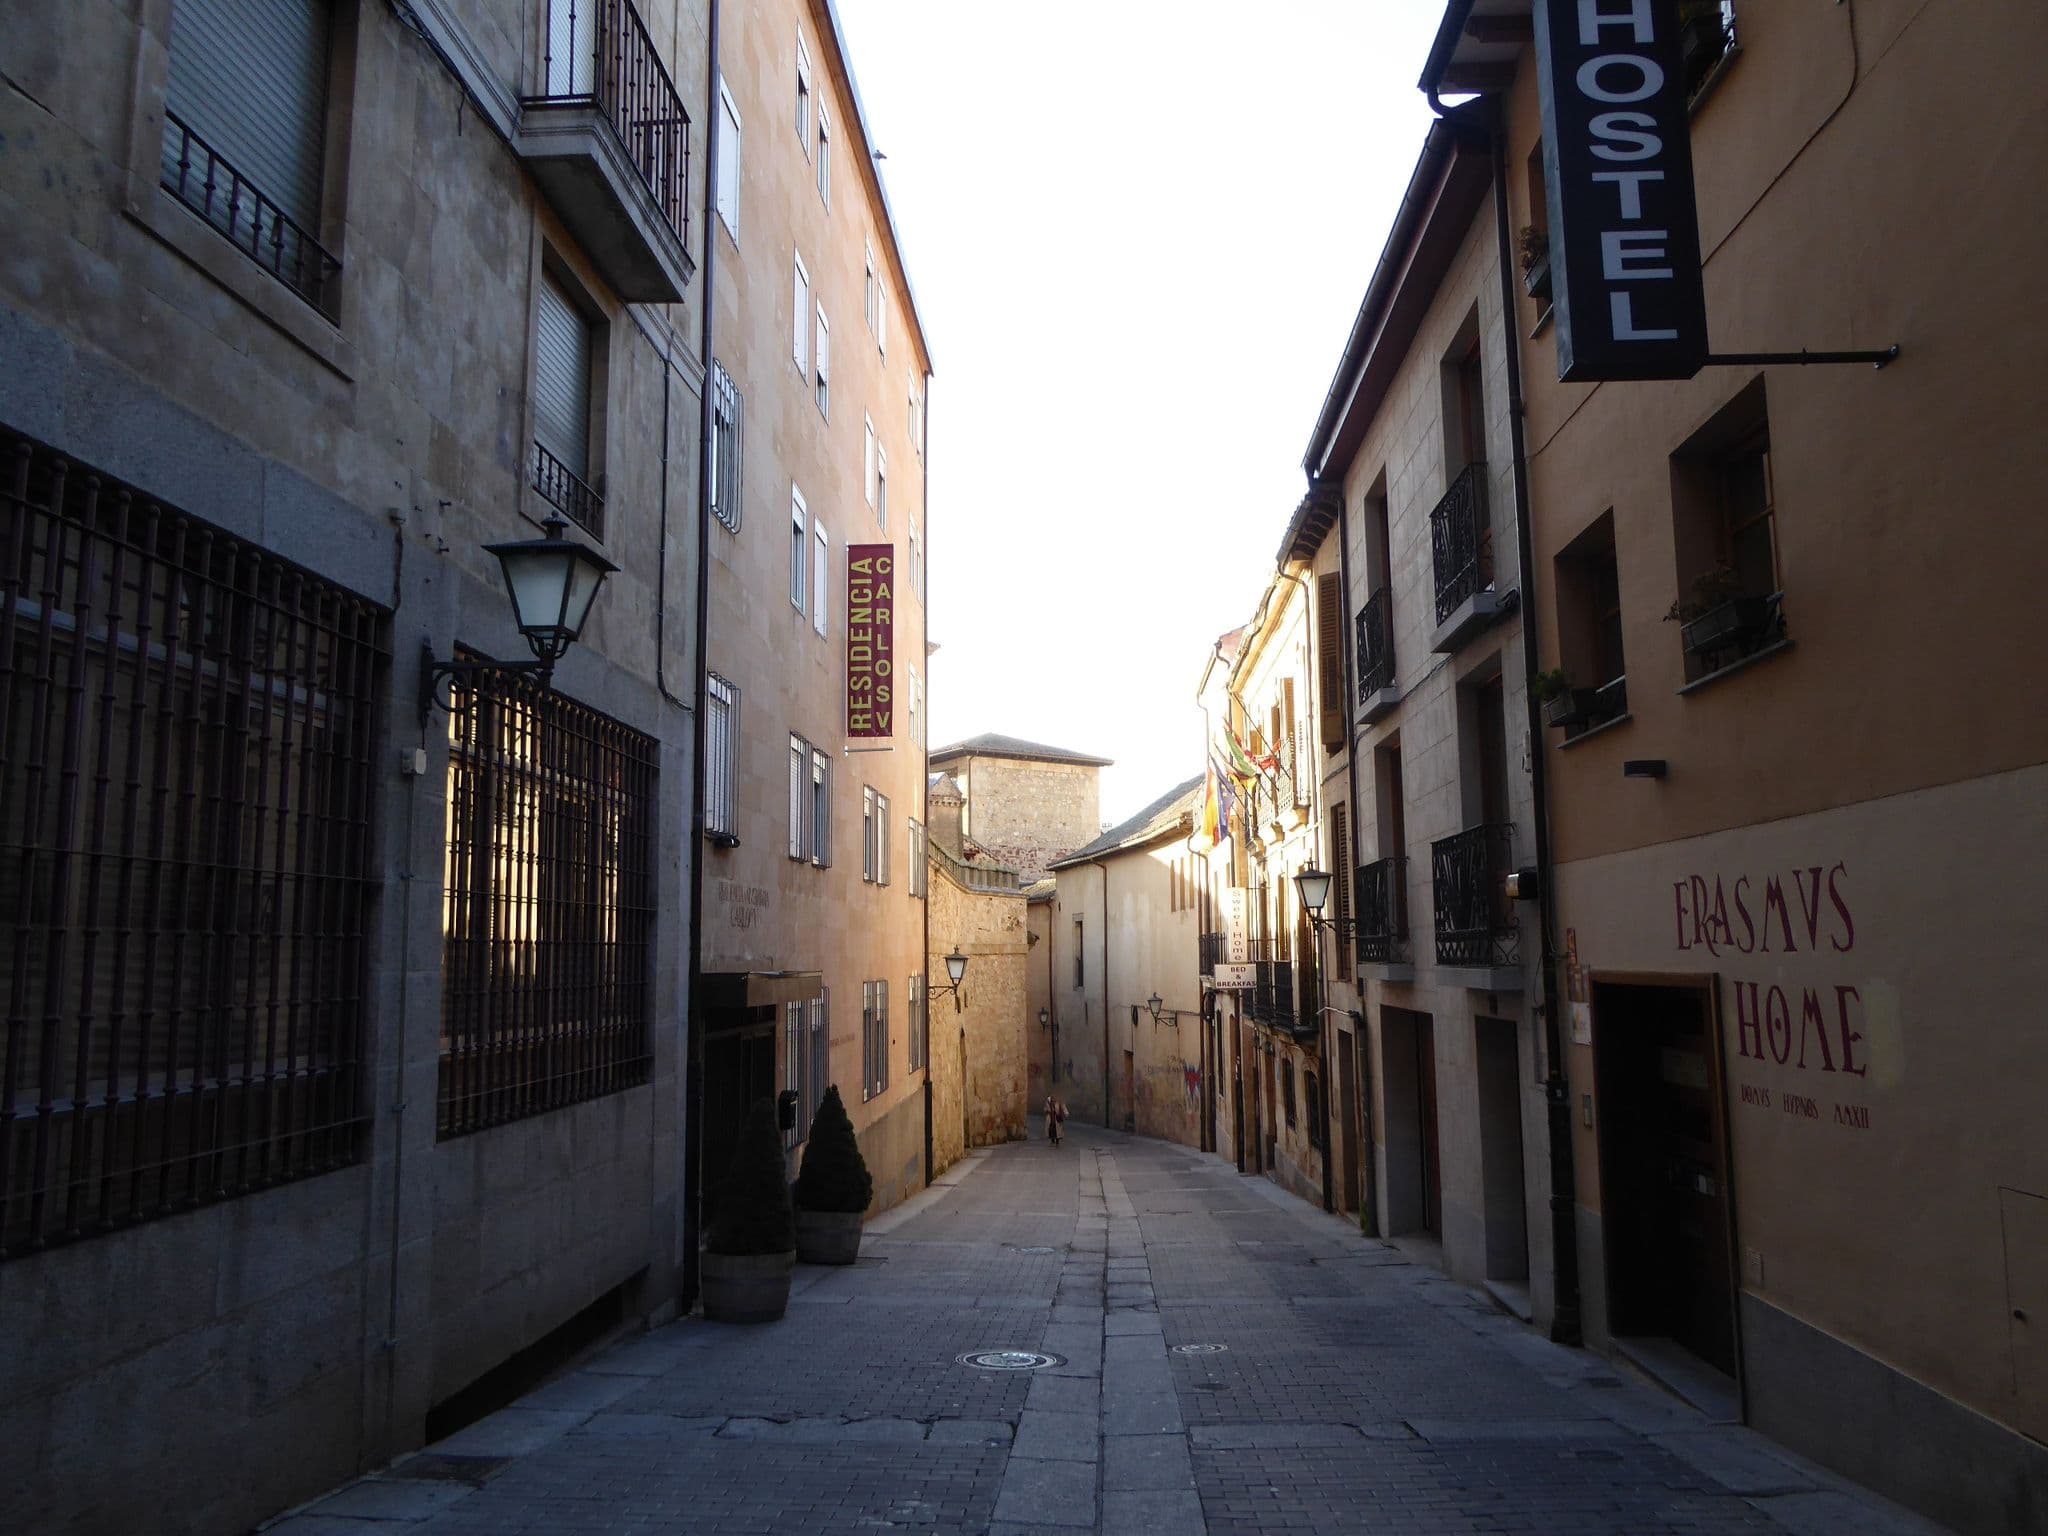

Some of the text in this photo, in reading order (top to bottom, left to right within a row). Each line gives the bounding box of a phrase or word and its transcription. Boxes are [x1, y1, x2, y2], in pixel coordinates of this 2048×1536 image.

[1576, 0, 1678, 341] HOSTEL
[850, 557, 873, 730] RESIDENCIA
[875, 556, 892, 729] CARLOS V
[1673, 860, 1855, 957] ERASMVS
[1733, 980, 1867, 1077] HOME
